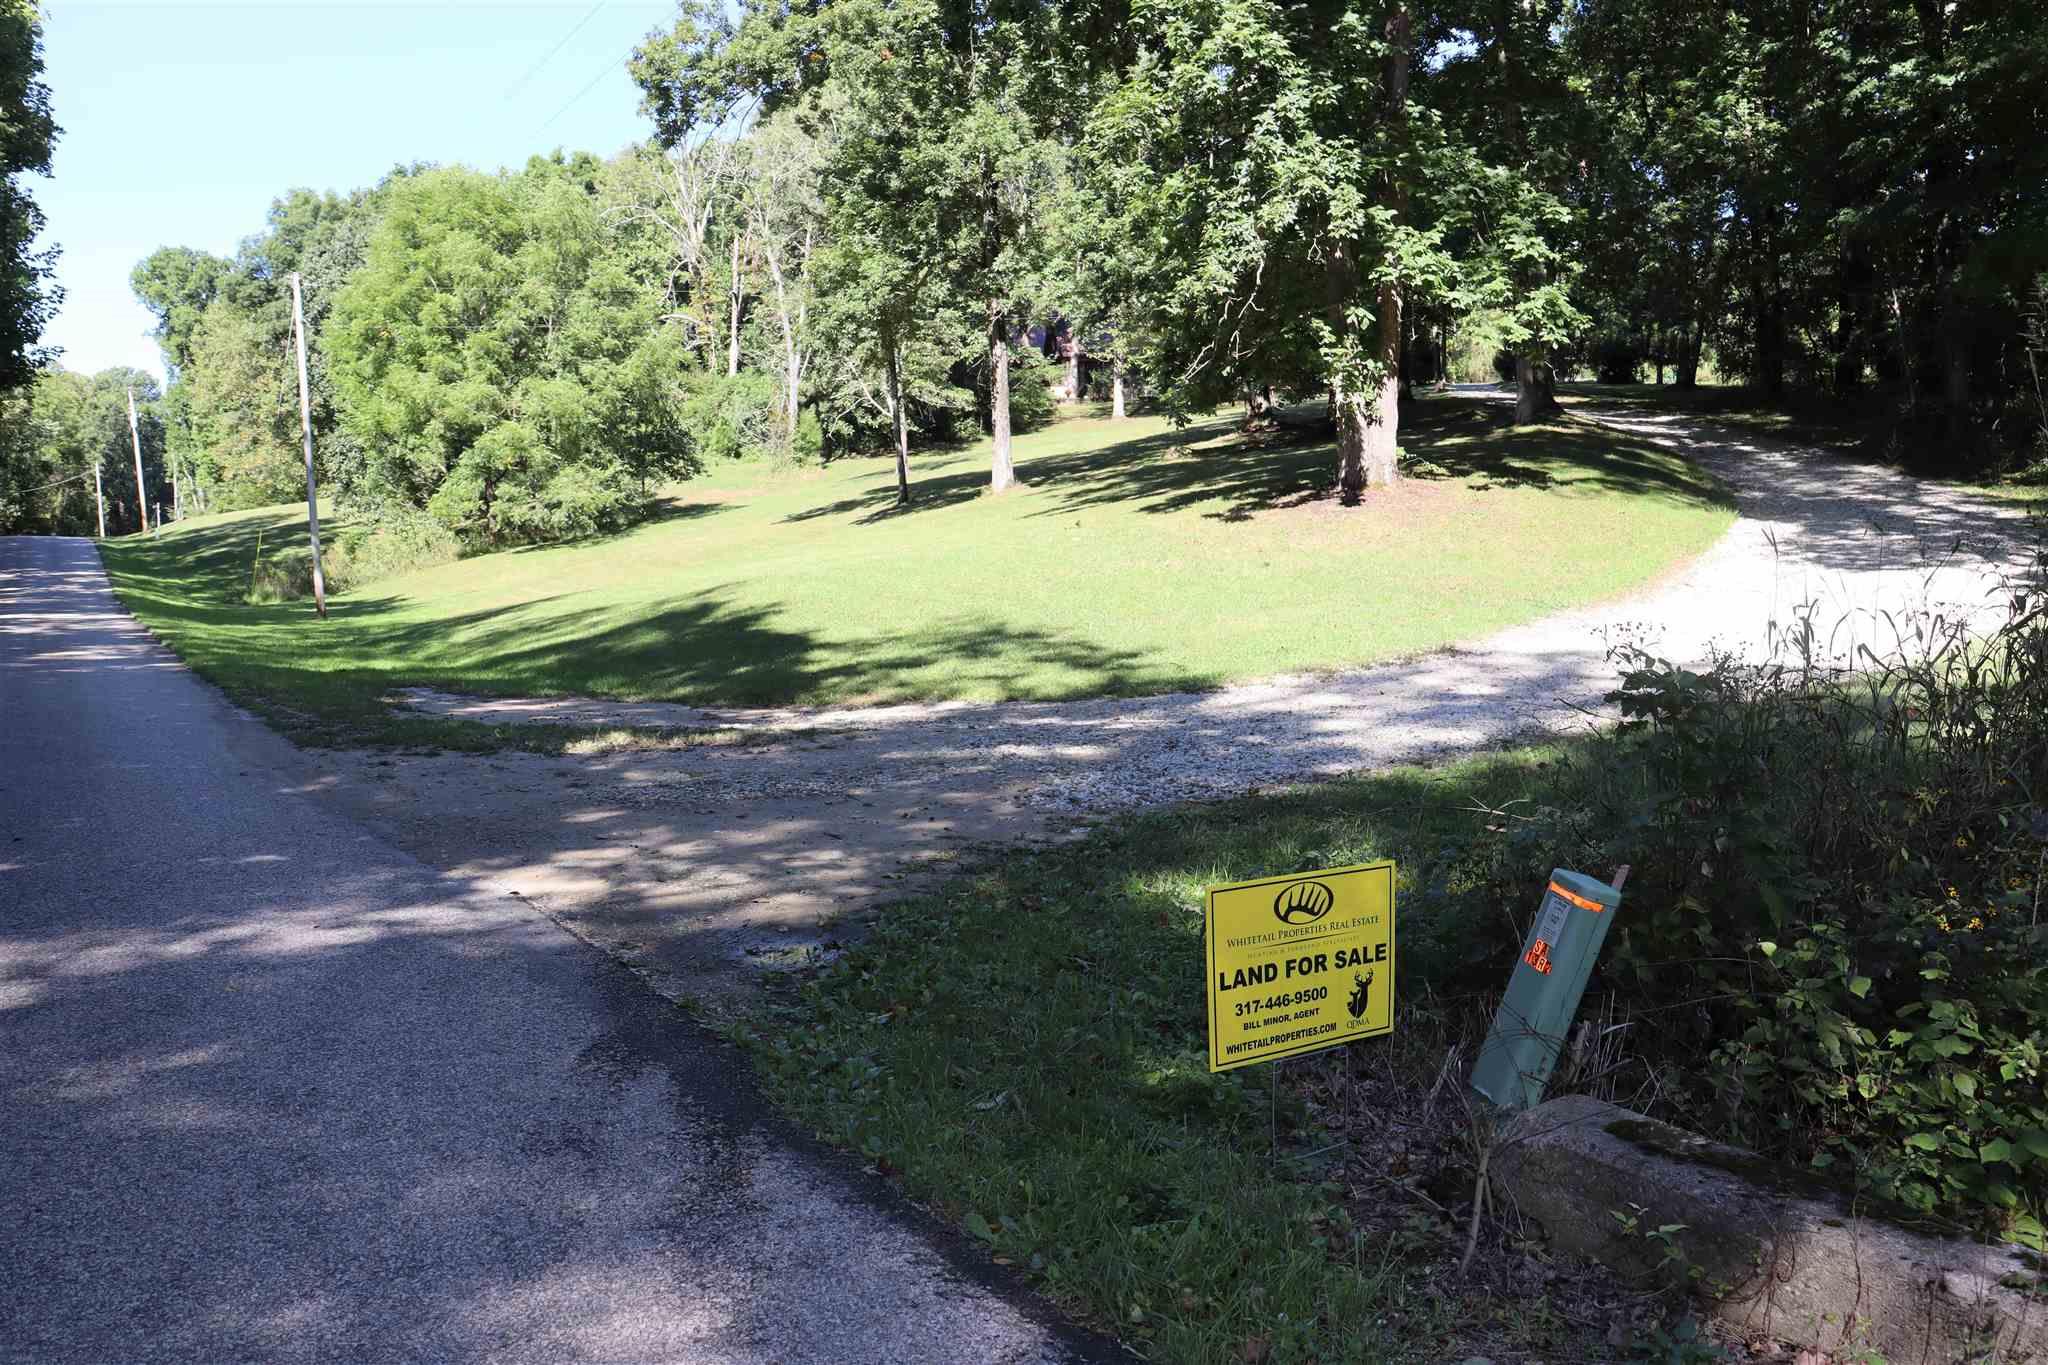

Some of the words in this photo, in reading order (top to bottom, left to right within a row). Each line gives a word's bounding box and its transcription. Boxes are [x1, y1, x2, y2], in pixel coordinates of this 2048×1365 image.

[1227, 933, 1276, 948] WHITETAIL
[1278, 924, 1327, 940] PROPERTIES
[1330, 920, 1350, 931] REAL
[1352, 915, 1379, 927] ESTATE
[1219, 963, 1278, 991] LAND
[1286, 953, 1328, 978] FOR
[1334, 943, 1388, 969] SALE
[1235, 986, 1328, 1017] 317-446-9500
[1243, 1020, 1262, 1031] BILL
[1293, 1007, 1320, 1019] AGENT
[1226, 1022, 1337, 1055] WHITETAILPROPERTIES.COM
